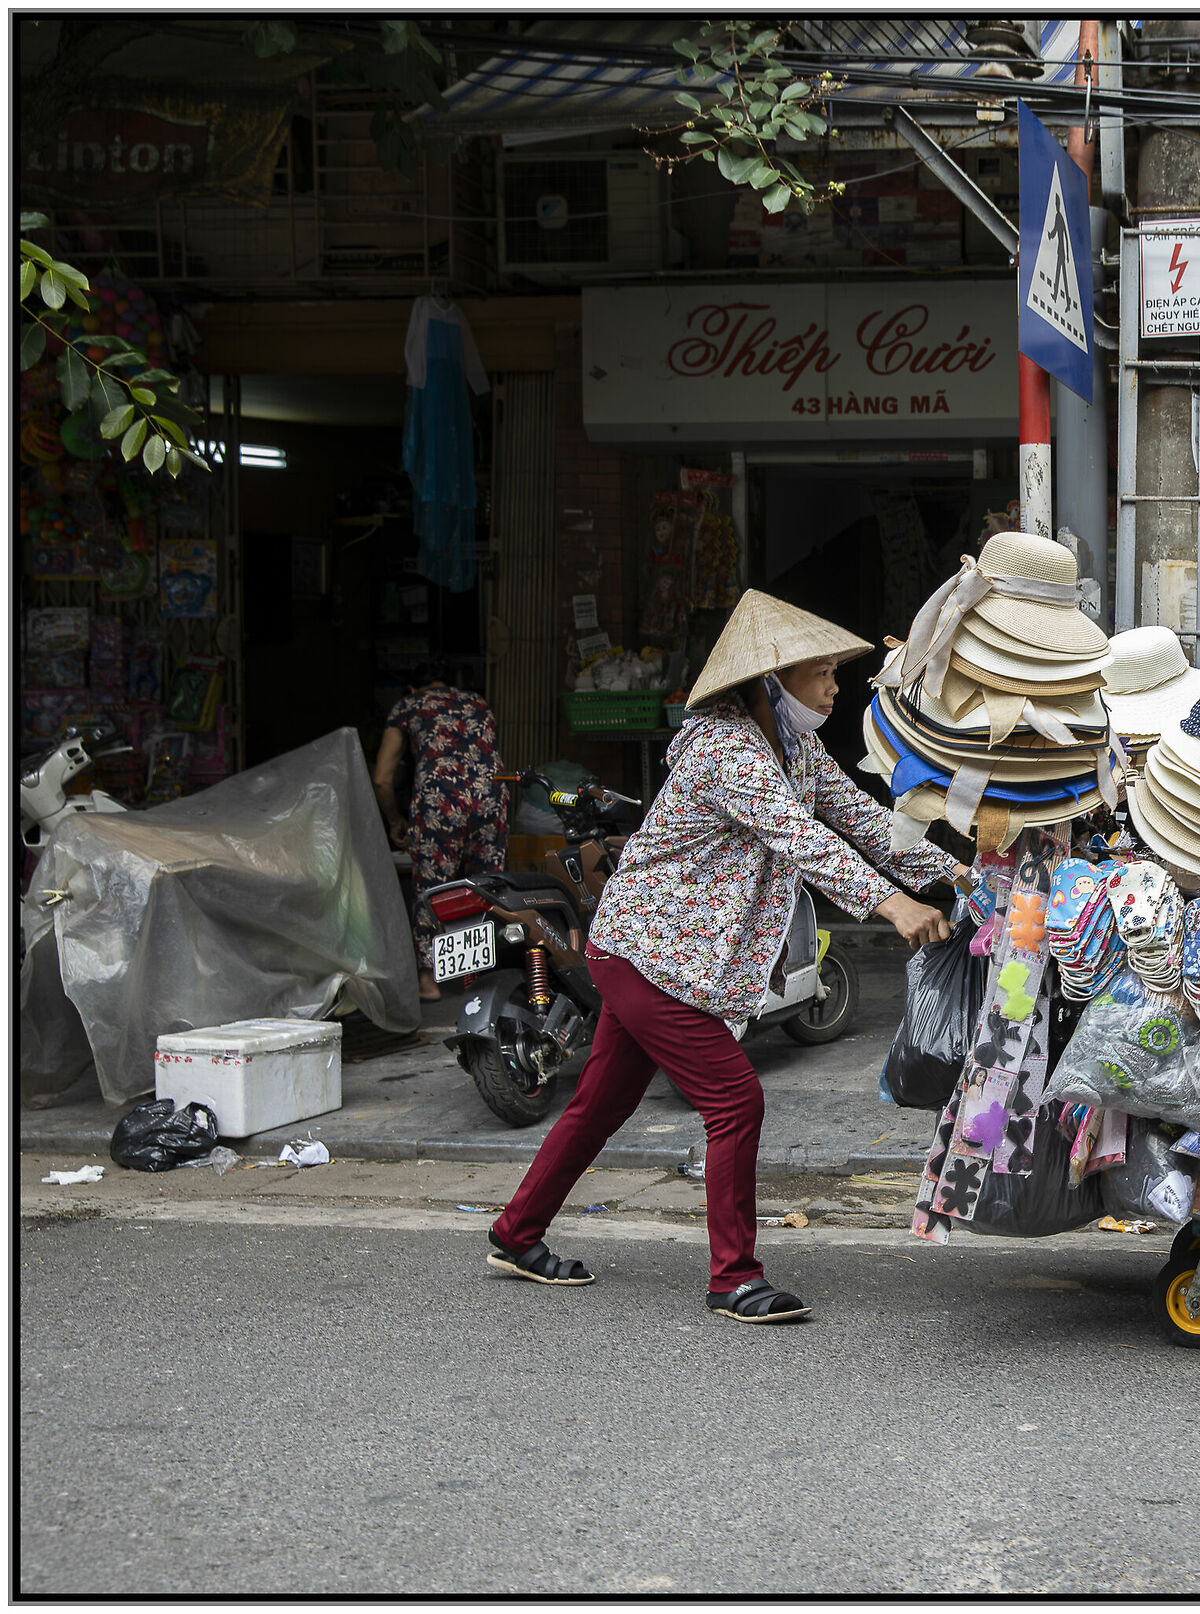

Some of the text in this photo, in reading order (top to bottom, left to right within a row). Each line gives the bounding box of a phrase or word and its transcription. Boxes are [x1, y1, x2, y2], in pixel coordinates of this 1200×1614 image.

[1150, 310, 1180, 321] NGUY
[668, 304, 996, 391] Thiếp Cưới
[792, 390, 950, 415] 43 HÀNG MÃ
[438, 947, 491, 977] 332.49
